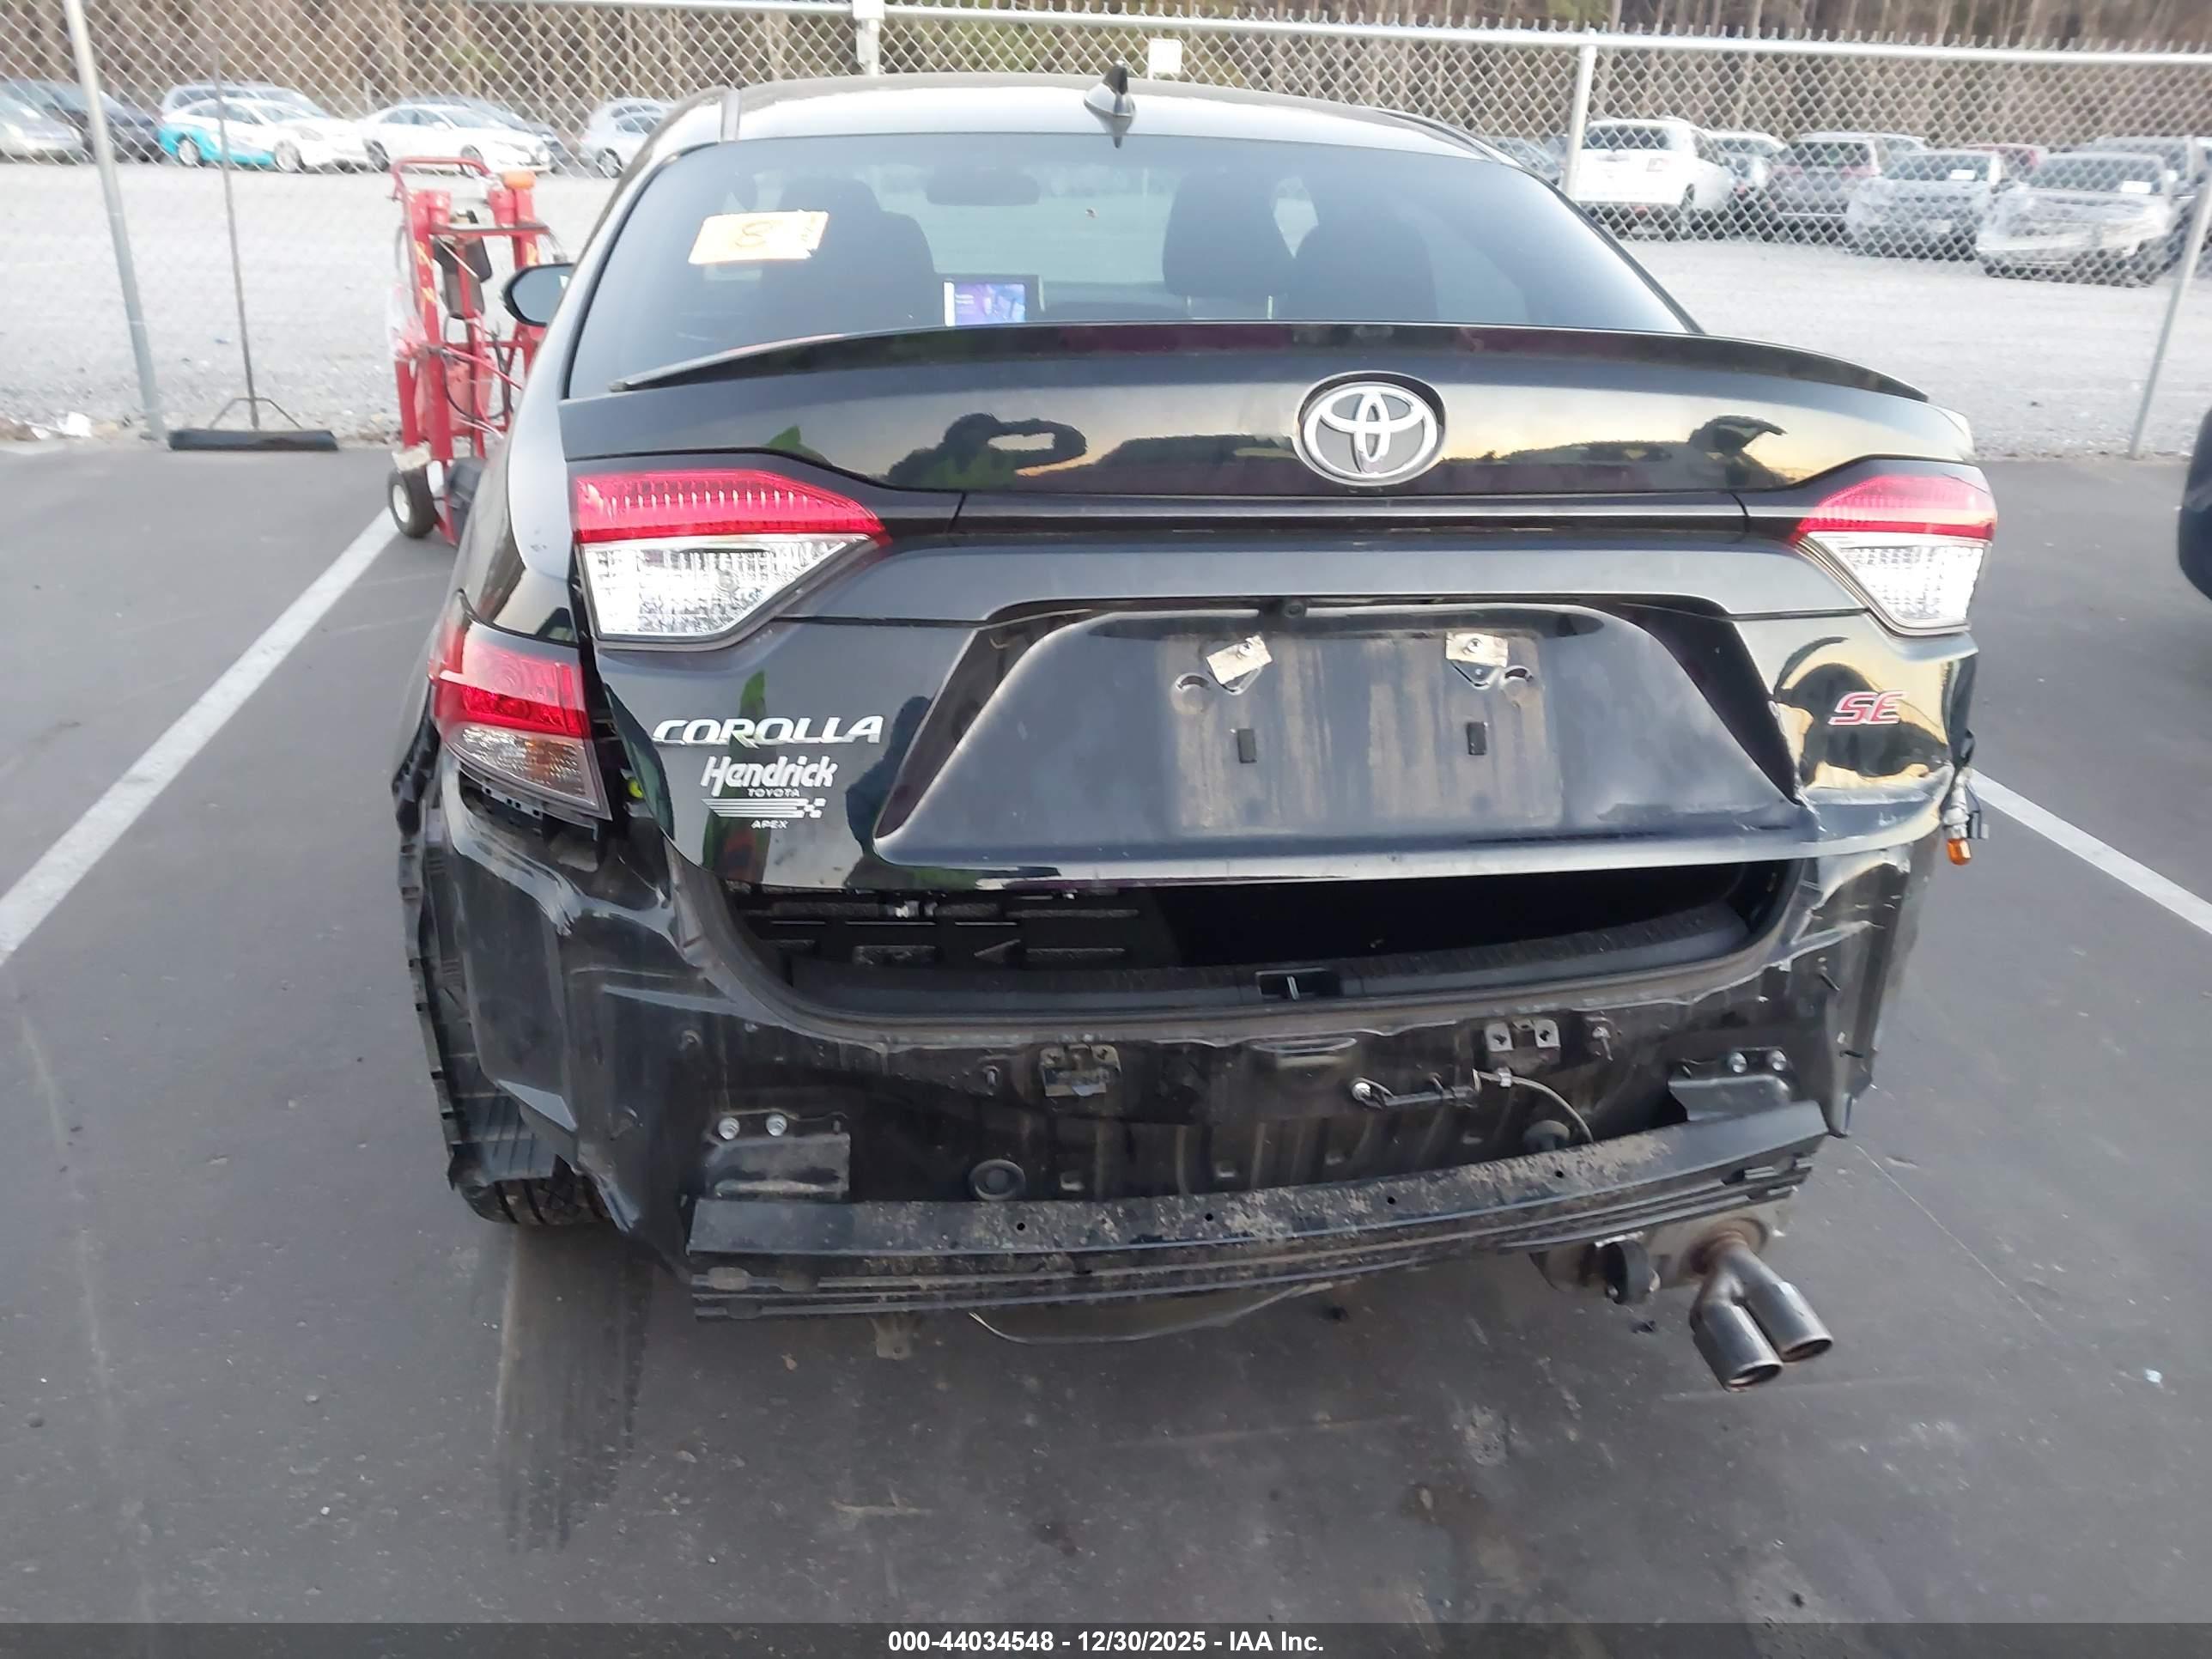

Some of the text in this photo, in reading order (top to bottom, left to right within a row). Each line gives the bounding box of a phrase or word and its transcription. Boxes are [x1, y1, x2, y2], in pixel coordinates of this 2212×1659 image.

[1827, 690, 1910, 726] SE
[651, 714, 884, 750] COROLLA
[700, 755, 839, 798] Hendrick
[747, 787, 800, 798] TOYOTA
[750, 819, 789, 830] APEX
